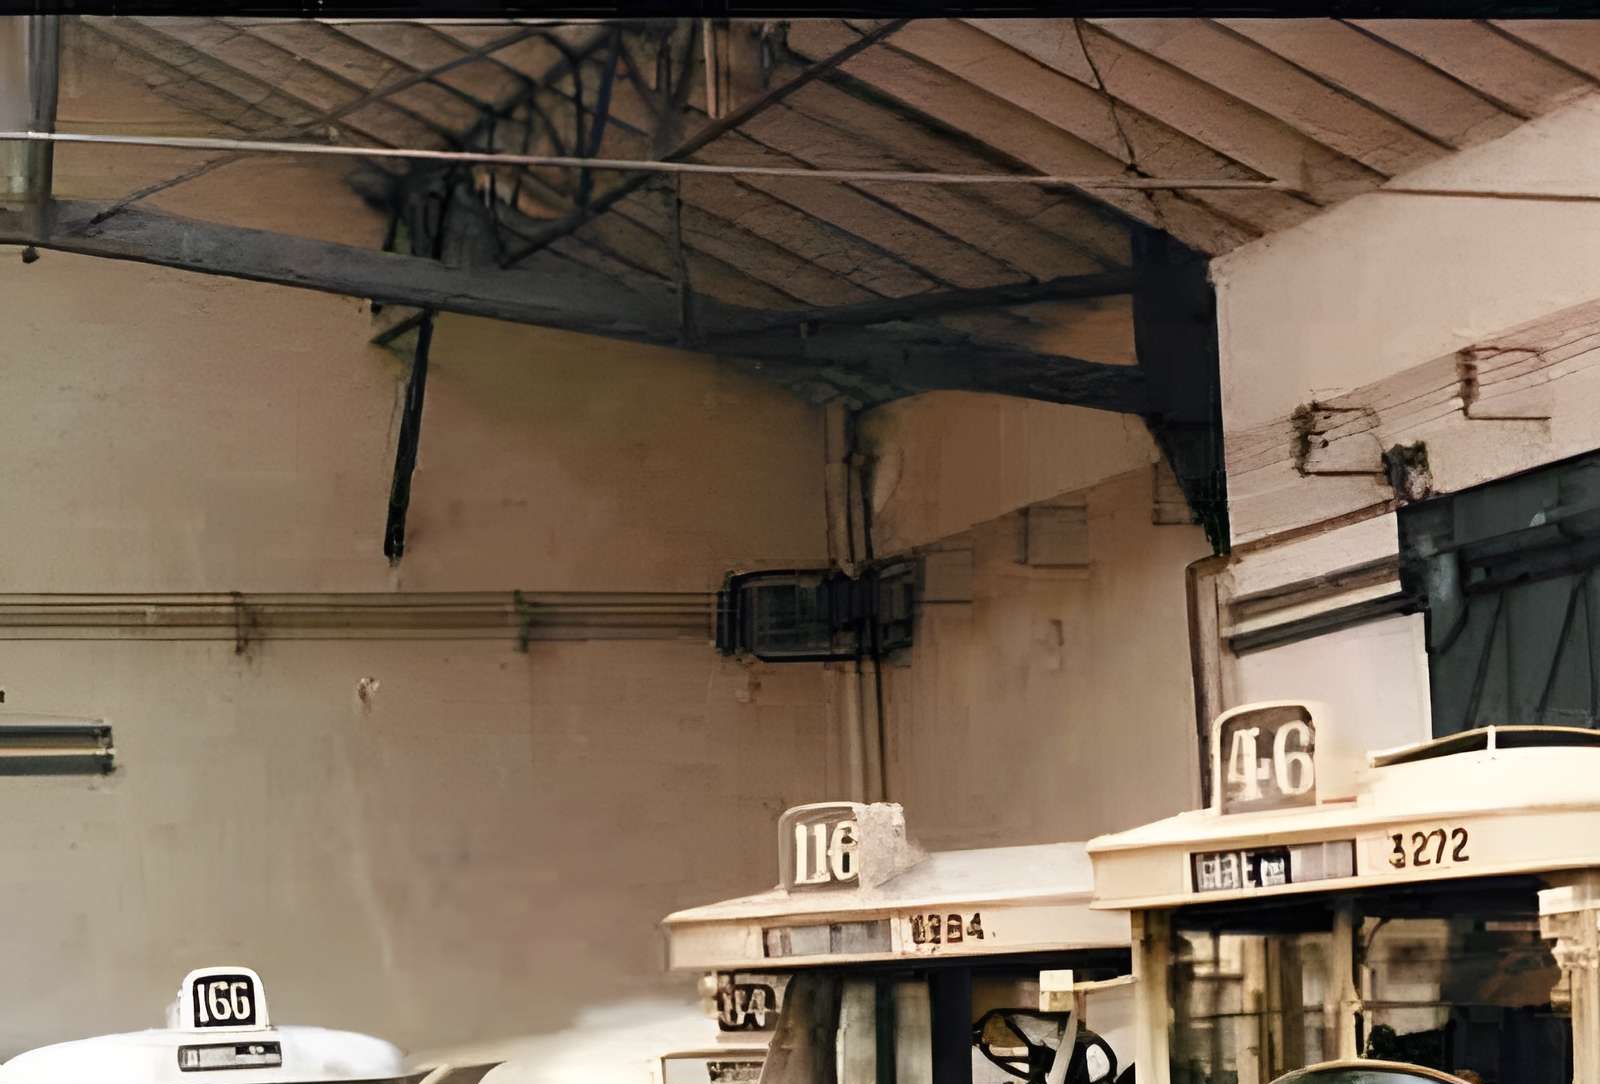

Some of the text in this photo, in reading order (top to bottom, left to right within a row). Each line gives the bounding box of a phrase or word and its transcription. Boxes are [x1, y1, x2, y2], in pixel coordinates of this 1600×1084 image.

[1227, 719, 1315, 801] 46
[794, 819, 859, 884] 116
[197, 981, 251, 1022] 166
